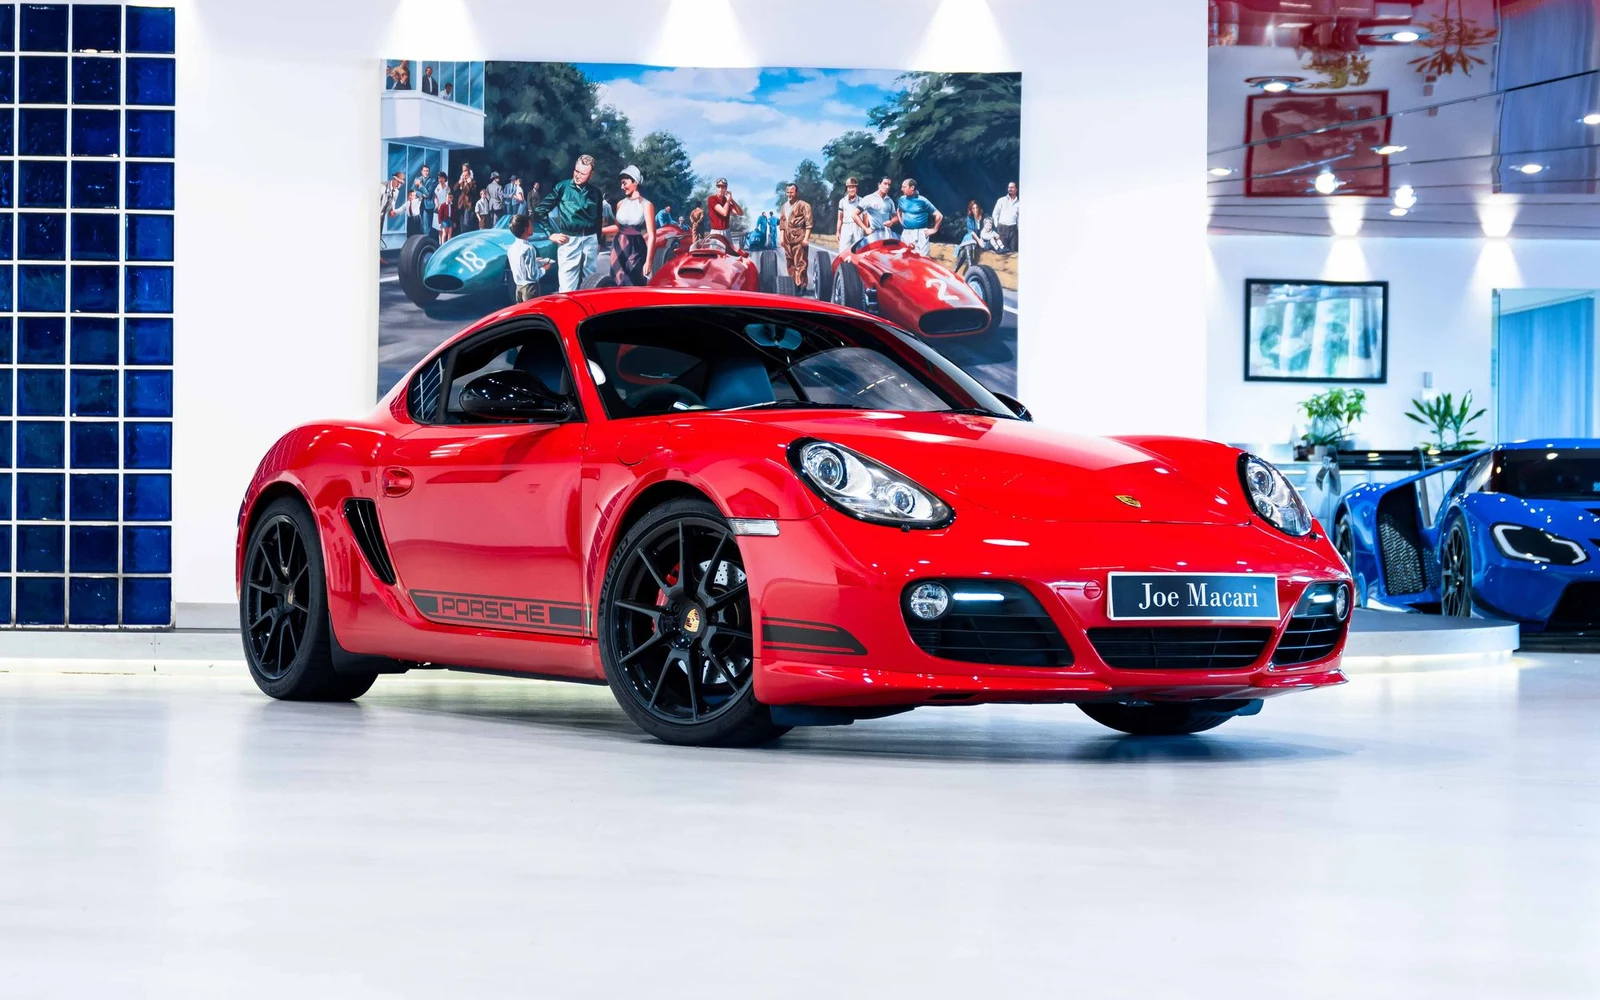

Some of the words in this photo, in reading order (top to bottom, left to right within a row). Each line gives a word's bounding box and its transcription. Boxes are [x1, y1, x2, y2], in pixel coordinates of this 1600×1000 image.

[455, 250, 486, 272] 18
[925, 278, 960, 301] 2
[1138, 582, 1180, 610] Joe
[1186, 582, 1259, 608] Macari
[441, 597, 545, 624] PORSCHE
